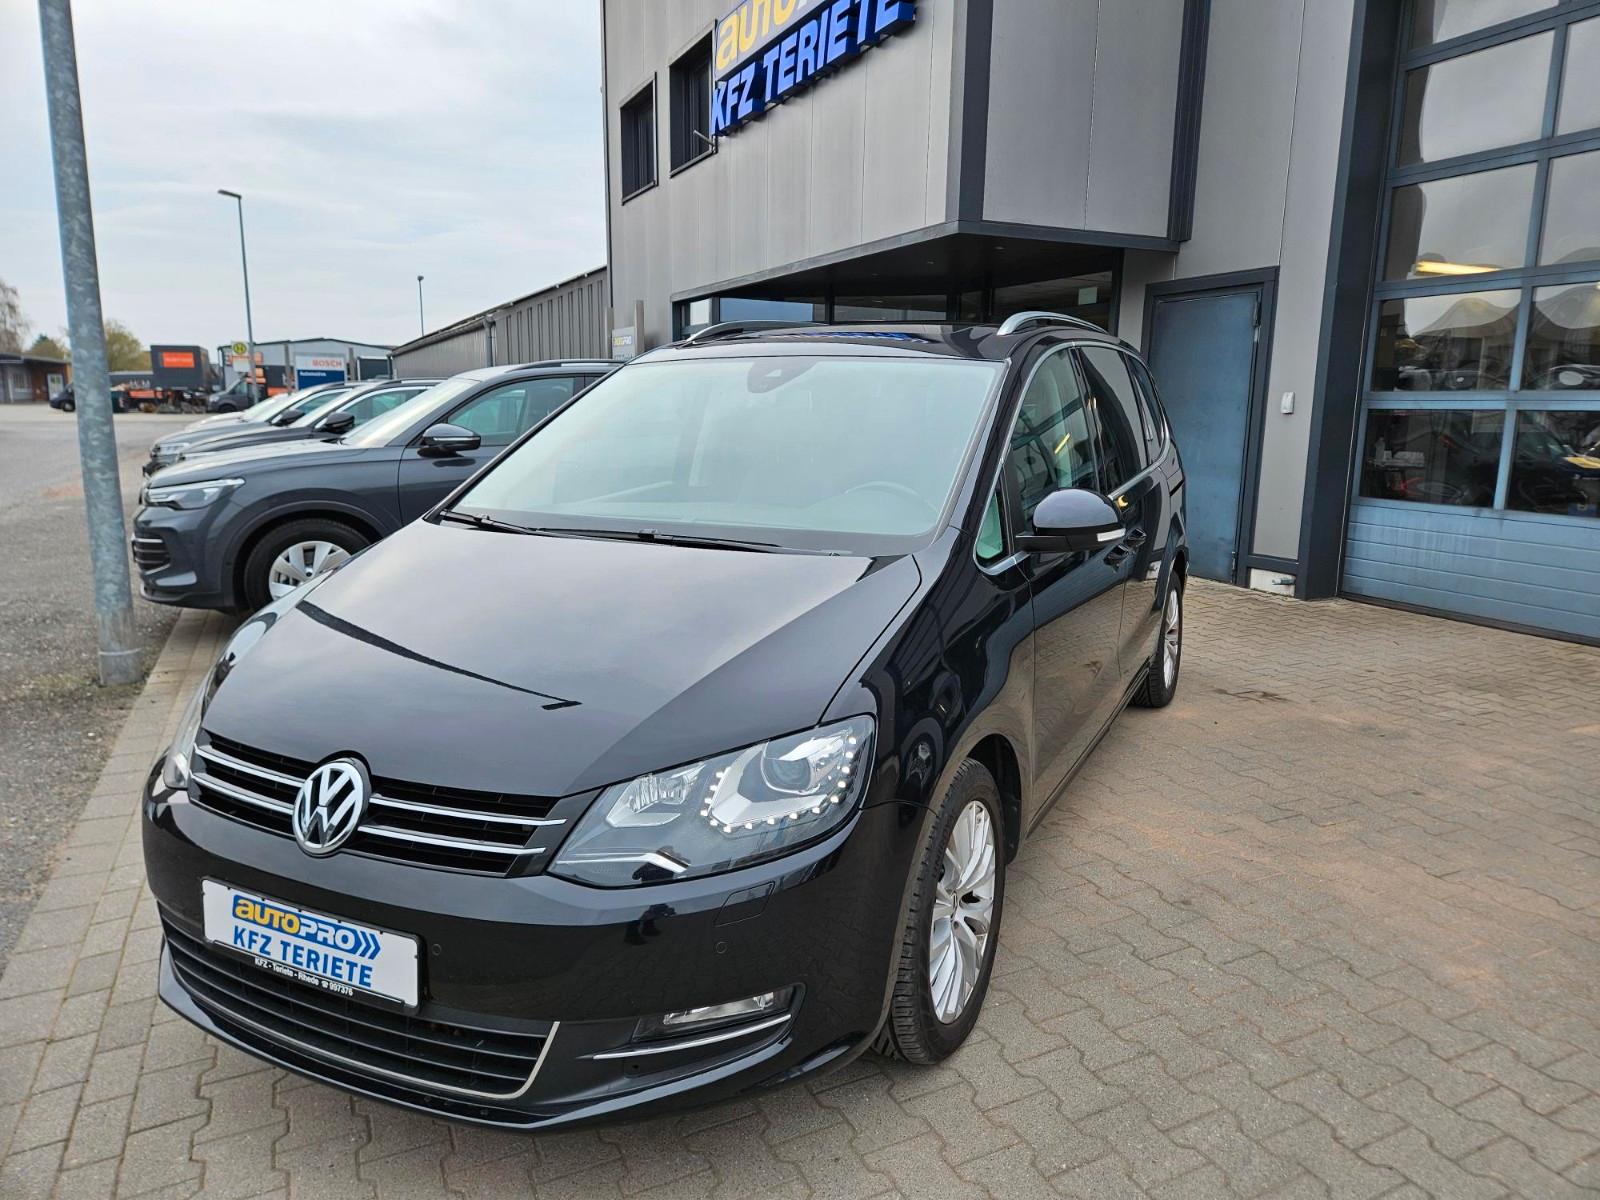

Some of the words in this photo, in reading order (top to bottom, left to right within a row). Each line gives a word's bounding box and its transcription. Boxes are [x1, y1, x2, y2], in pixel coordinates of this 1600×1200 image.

[710, 62, 755, 136] KFZ
[763, 0, 900, 102] TERIETE
[312, 359, 343, 368] BOSCH
[233, 925, 272, 956] KFZ
[280, 940, 373, 988] TERIETE
[254, 957, 268, 970] KFZ
